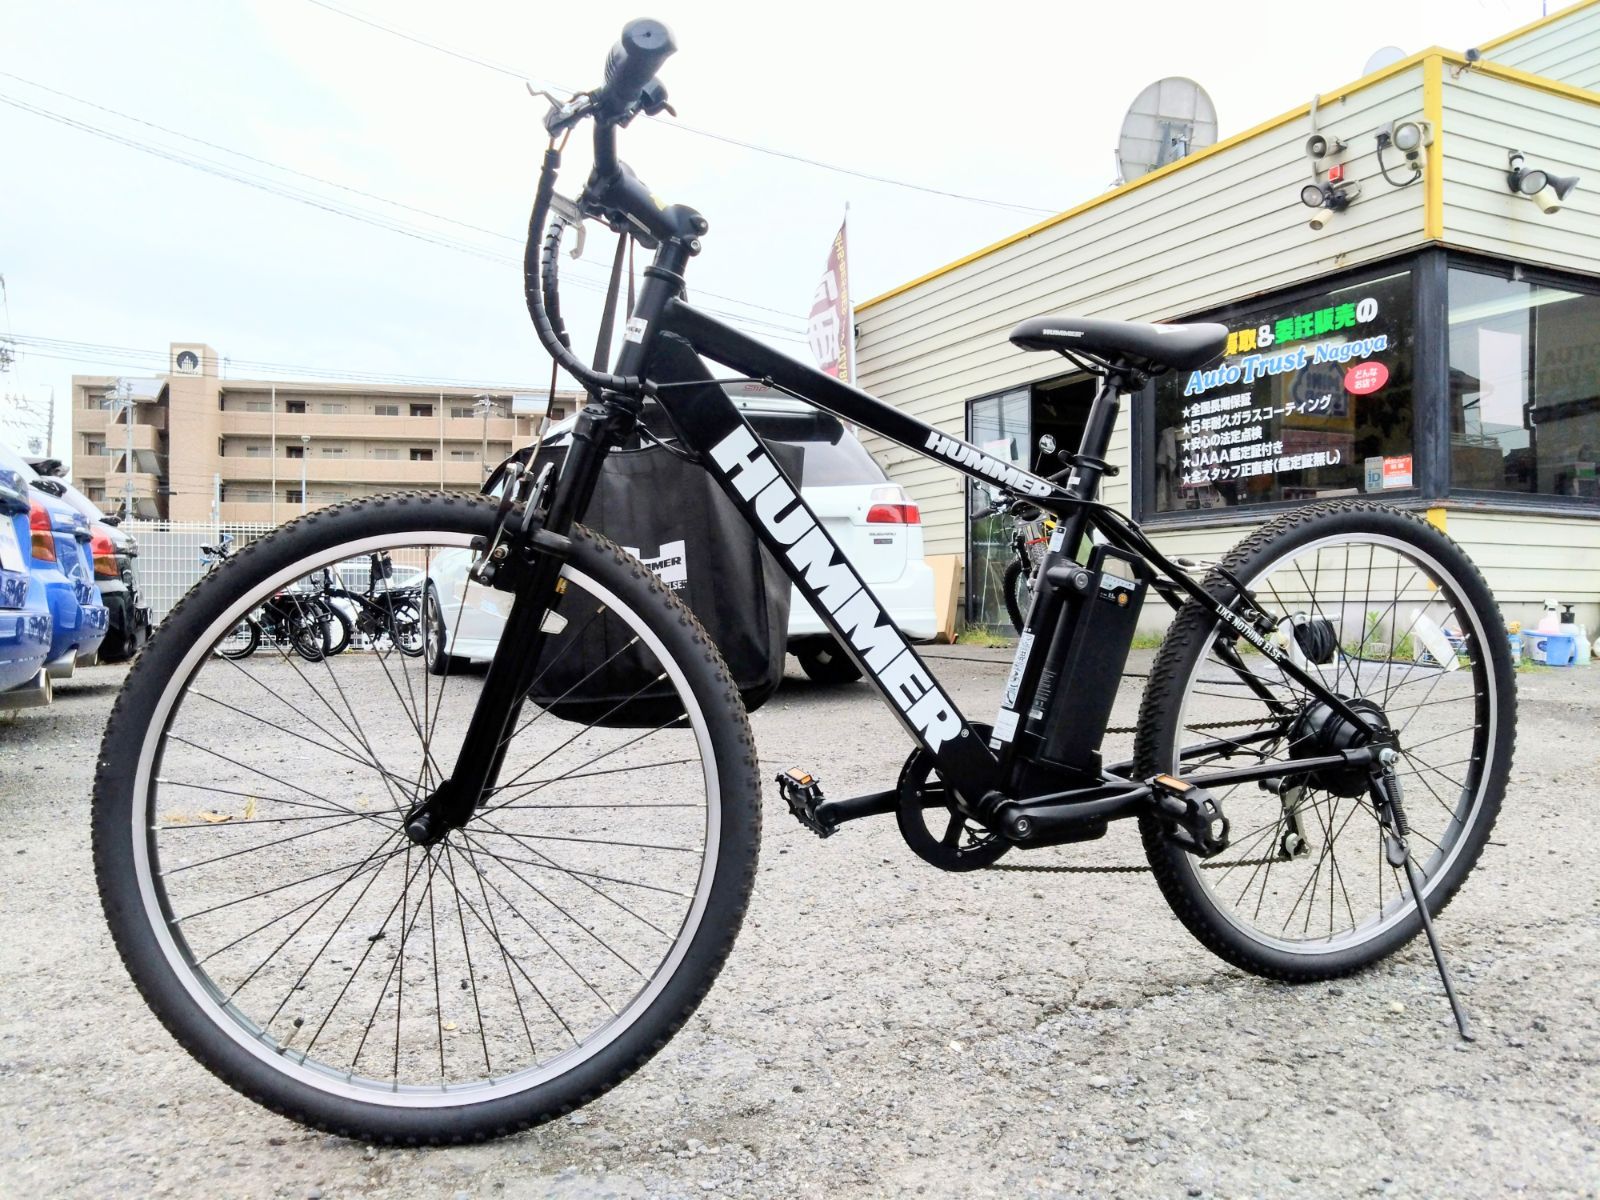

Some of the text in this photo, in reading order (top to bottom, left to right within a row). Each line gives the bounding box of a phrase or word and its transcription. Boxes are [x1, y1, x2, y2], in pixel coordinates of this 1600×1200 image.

[1184, 334, 1389, 396] Auto Trust Nagoya
[924, 431, 1052, 497] HUMMER
[709, 424, 962, 754] HUMMER
[1215, 604, 1233, 622] LIKE
[1231, 617, 1264, 646] NOTHING
